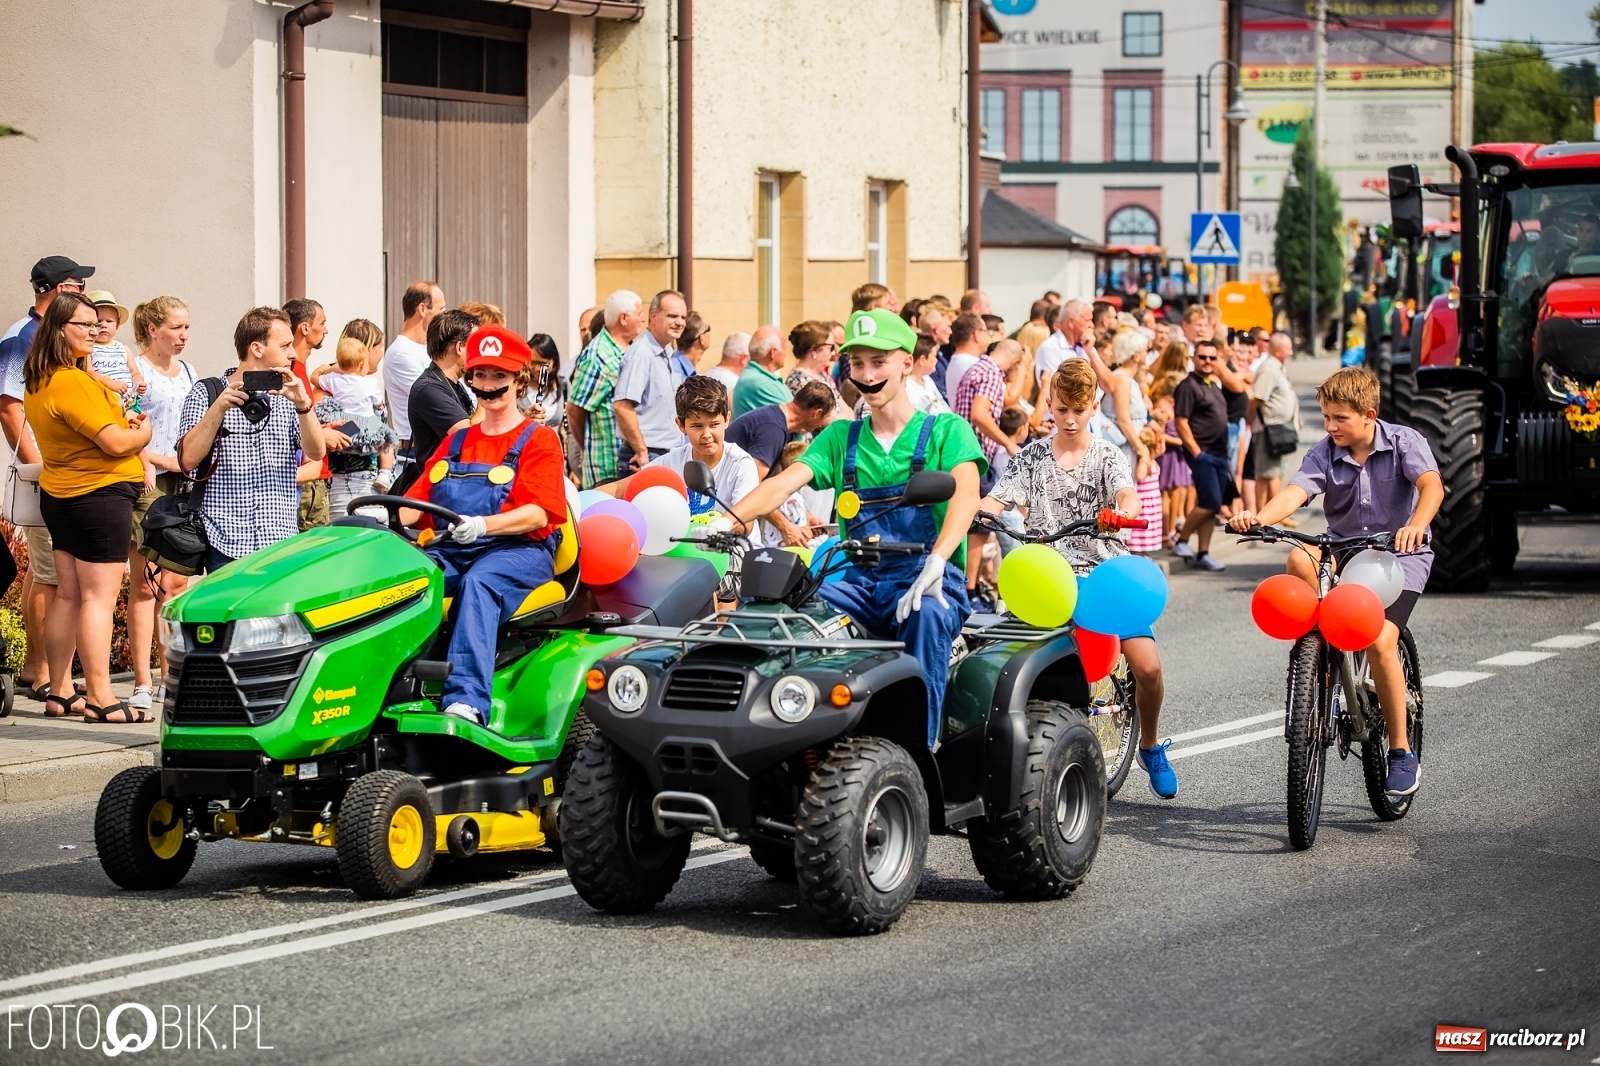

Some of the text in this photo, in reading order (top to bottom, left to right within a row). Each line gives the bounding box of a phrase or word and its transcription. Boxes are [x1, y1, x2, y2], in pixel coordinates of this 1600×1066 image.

[1035, 29, 1101, 45] WIELKIE
[858, 319, 870, 336] L
[481, 339, 500, 353] M
[379, 583, 415, 607] JOHN DEERE
[311, 704, 351, 725] X350R
